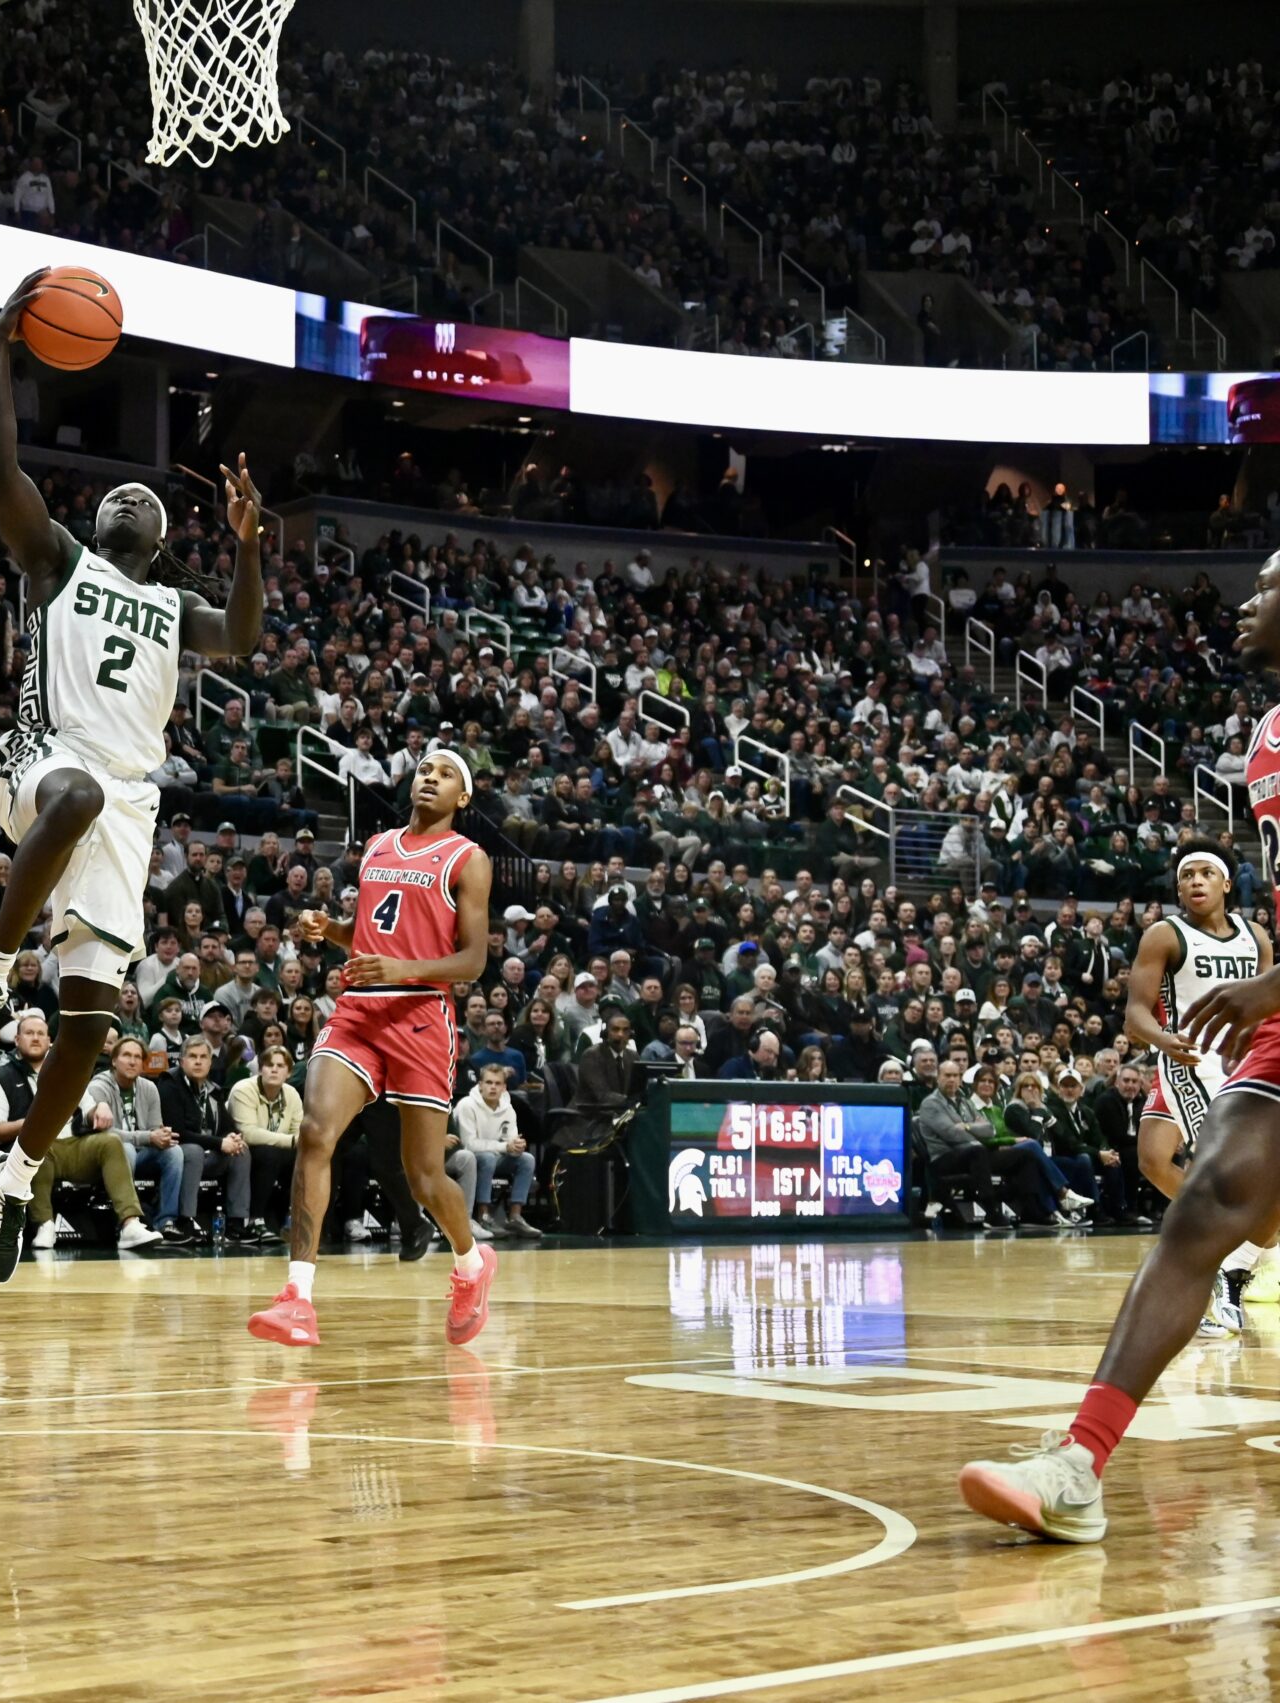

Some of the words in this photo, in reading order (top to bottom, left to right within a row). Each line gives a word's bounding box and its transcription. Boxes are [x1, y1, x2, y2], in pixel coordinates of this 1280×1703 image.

[412, 369, 484, 386] BUICK
[73, 581, 176, 650] STATE
[95, 634, 137, 693] 2
[362, 866, 401, 883] DETROIT
[400, 869, 436, 888] MERCY
[372, 889, 403, 935] 4
[1194, 955, 1258, 979] STATE
[730, 1105, 752, 1150] 5
[758, 1111, 819, 1143] 16:51
[824, 1105, 843, 1150] 0
[773, 1167, 805, 1196] 1ST
